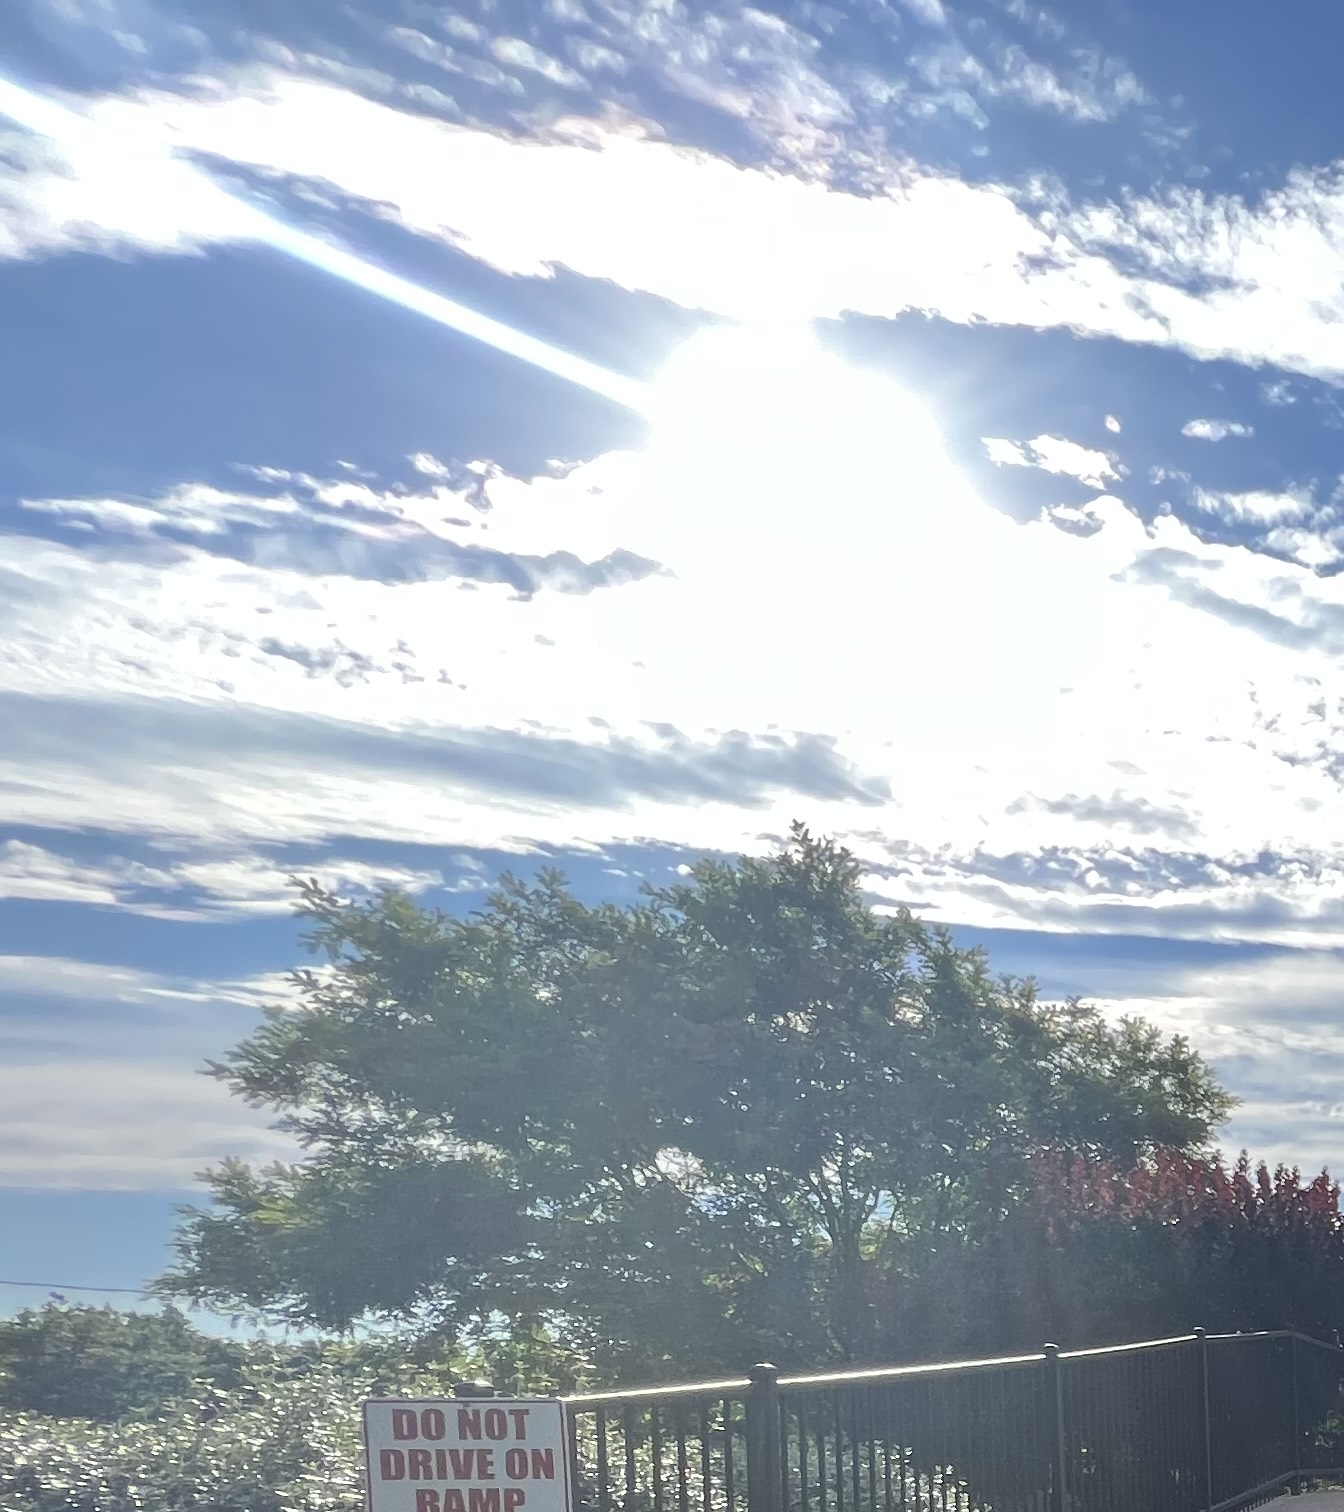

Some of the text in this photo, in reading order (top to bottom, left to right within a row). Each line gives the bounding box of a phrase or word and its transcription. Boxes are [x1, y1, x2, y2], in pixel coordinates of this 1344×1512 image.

[392, 1408, 530, 1441] DO NOT
[380, 1448, 554, 1481] DRIVE ON
